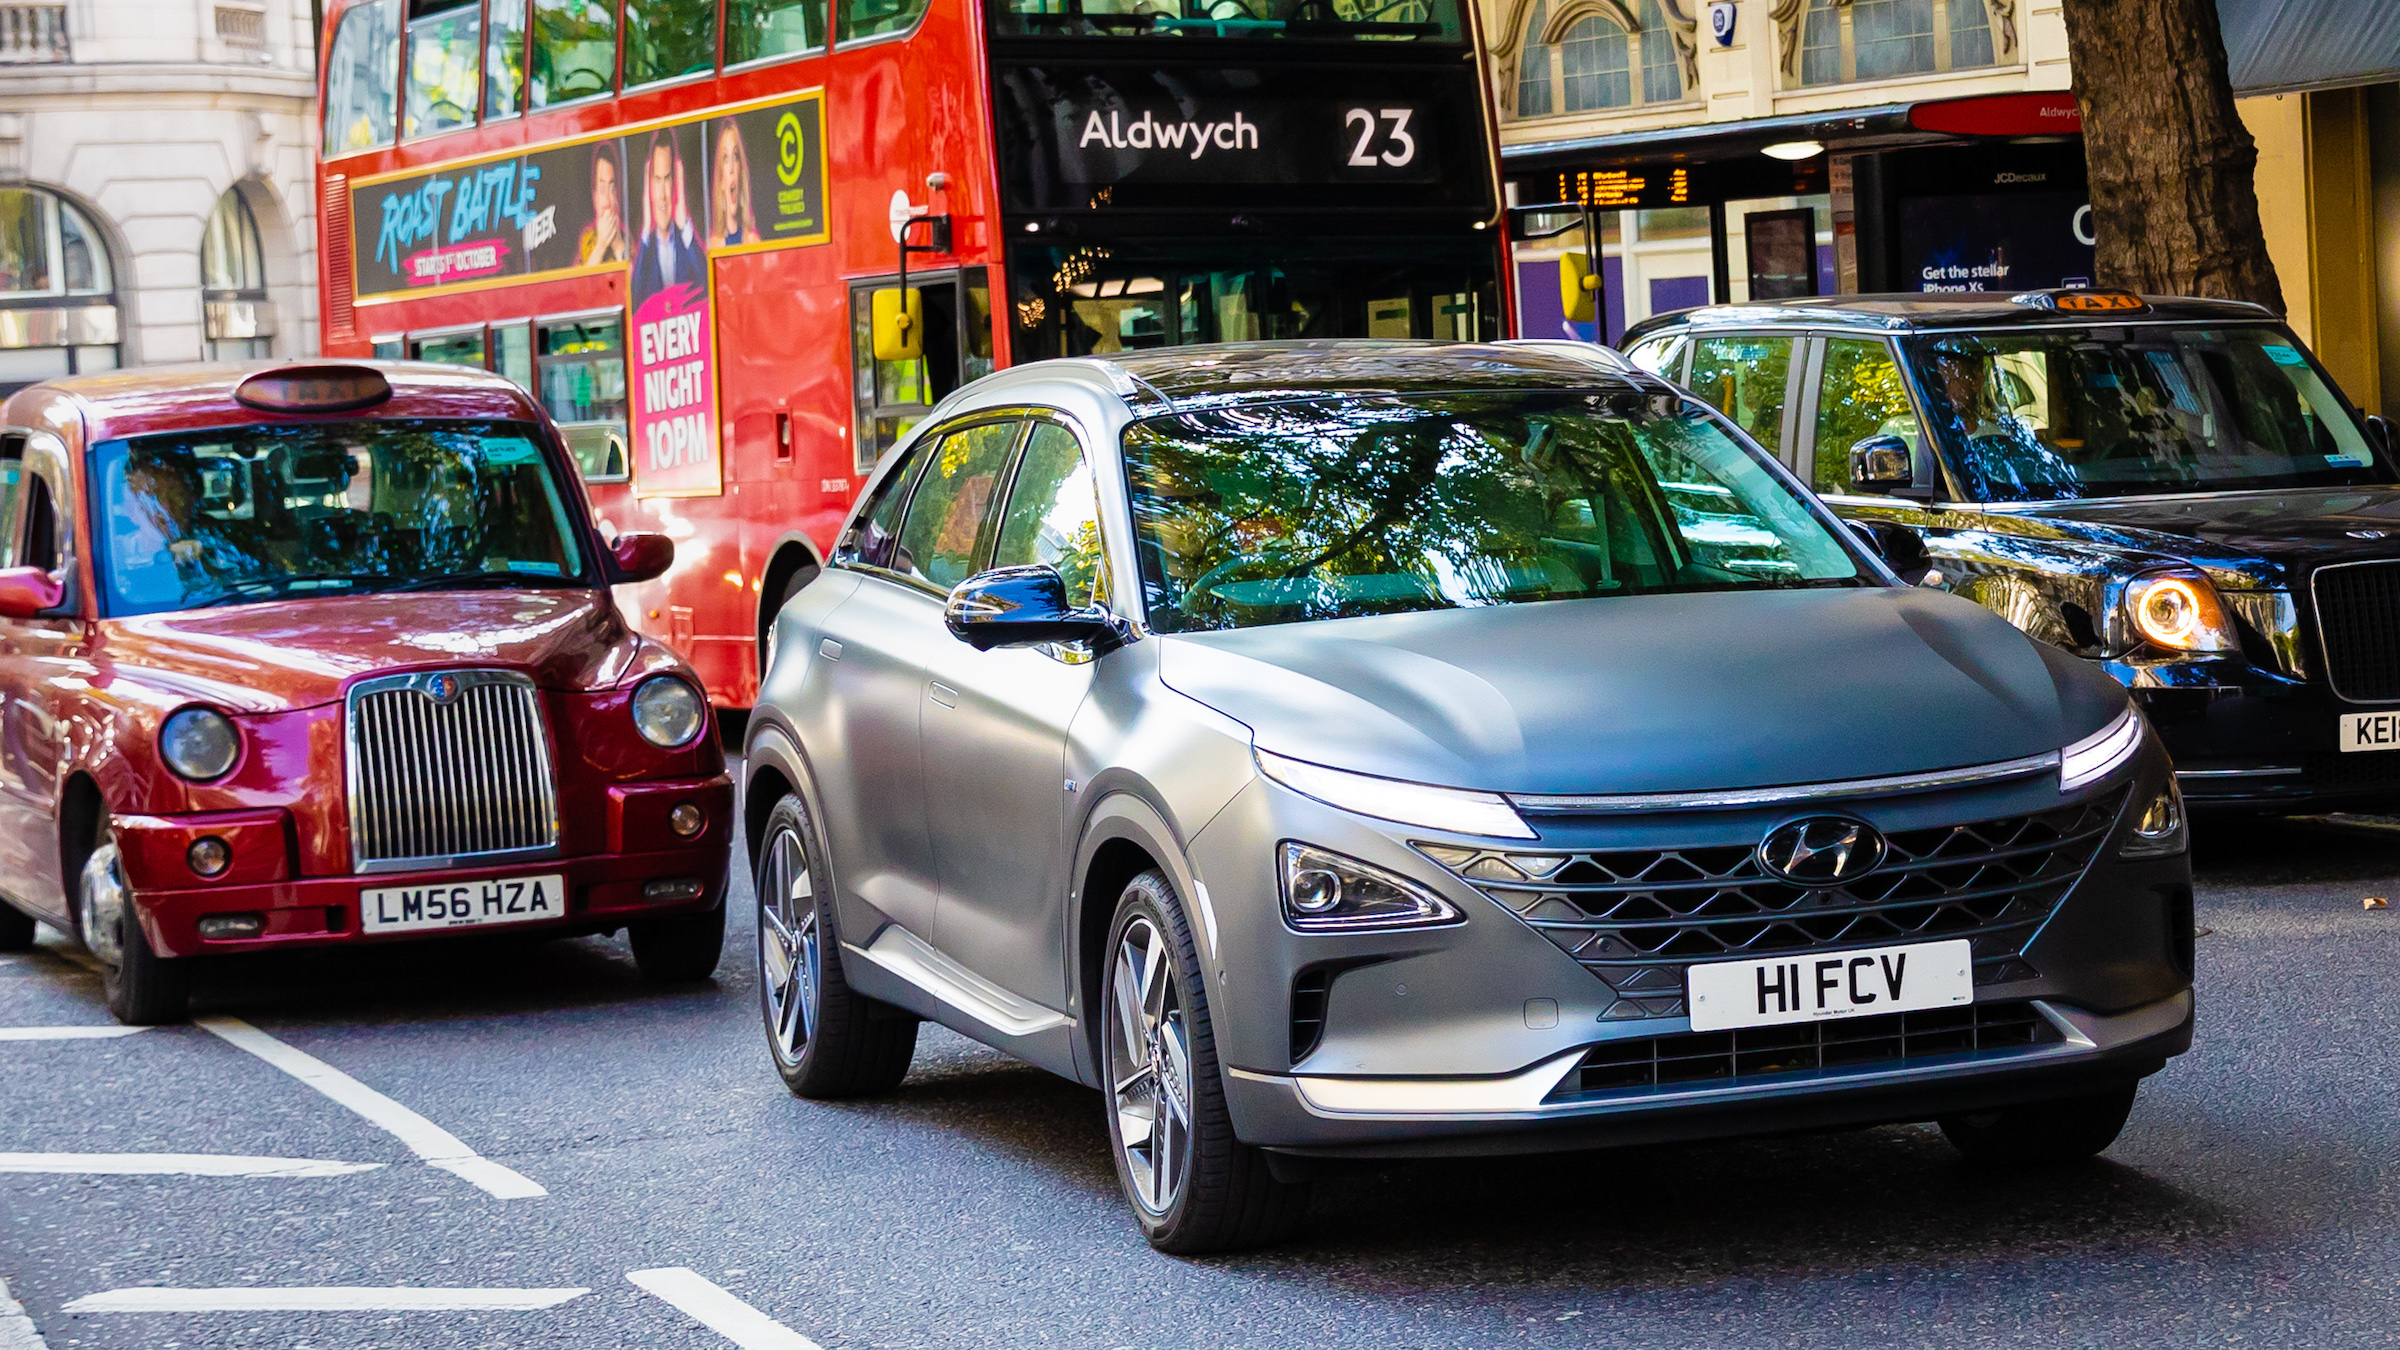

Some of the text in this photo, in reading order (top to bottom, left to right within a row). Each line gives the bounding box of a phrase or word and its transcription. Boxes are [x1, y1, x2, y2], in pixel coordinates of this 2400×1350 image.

[2039, 106, 2079, 119] Aldwyc
[1080, 108, 1415, 167] Aldwych 23
[1994, 172, 2047, 184] JCDecaux
[375, 160, 541, 275] ROAST BATTLE
[522, 205, 557, 250] WEEK
[414, 254, 444, 277] STARTS
[456, 245, 497, 271] OCTOBER
[1922, 264, 2010, 280] Get the stellar
[1922, 283, 1967, 293] iPhone
[2064, 296, 2137, 309] TAXI
[640, 311, 702, 366] EVERY
[644, 360, 704, 414] NIGHT
[646, 412, 709, 472] 10PM
[2357, 716, 2400, 744] KE1
[378, 881, 548, 923] LM56 HZA
[1756, 953, 1906, 1014] H1 FCV
